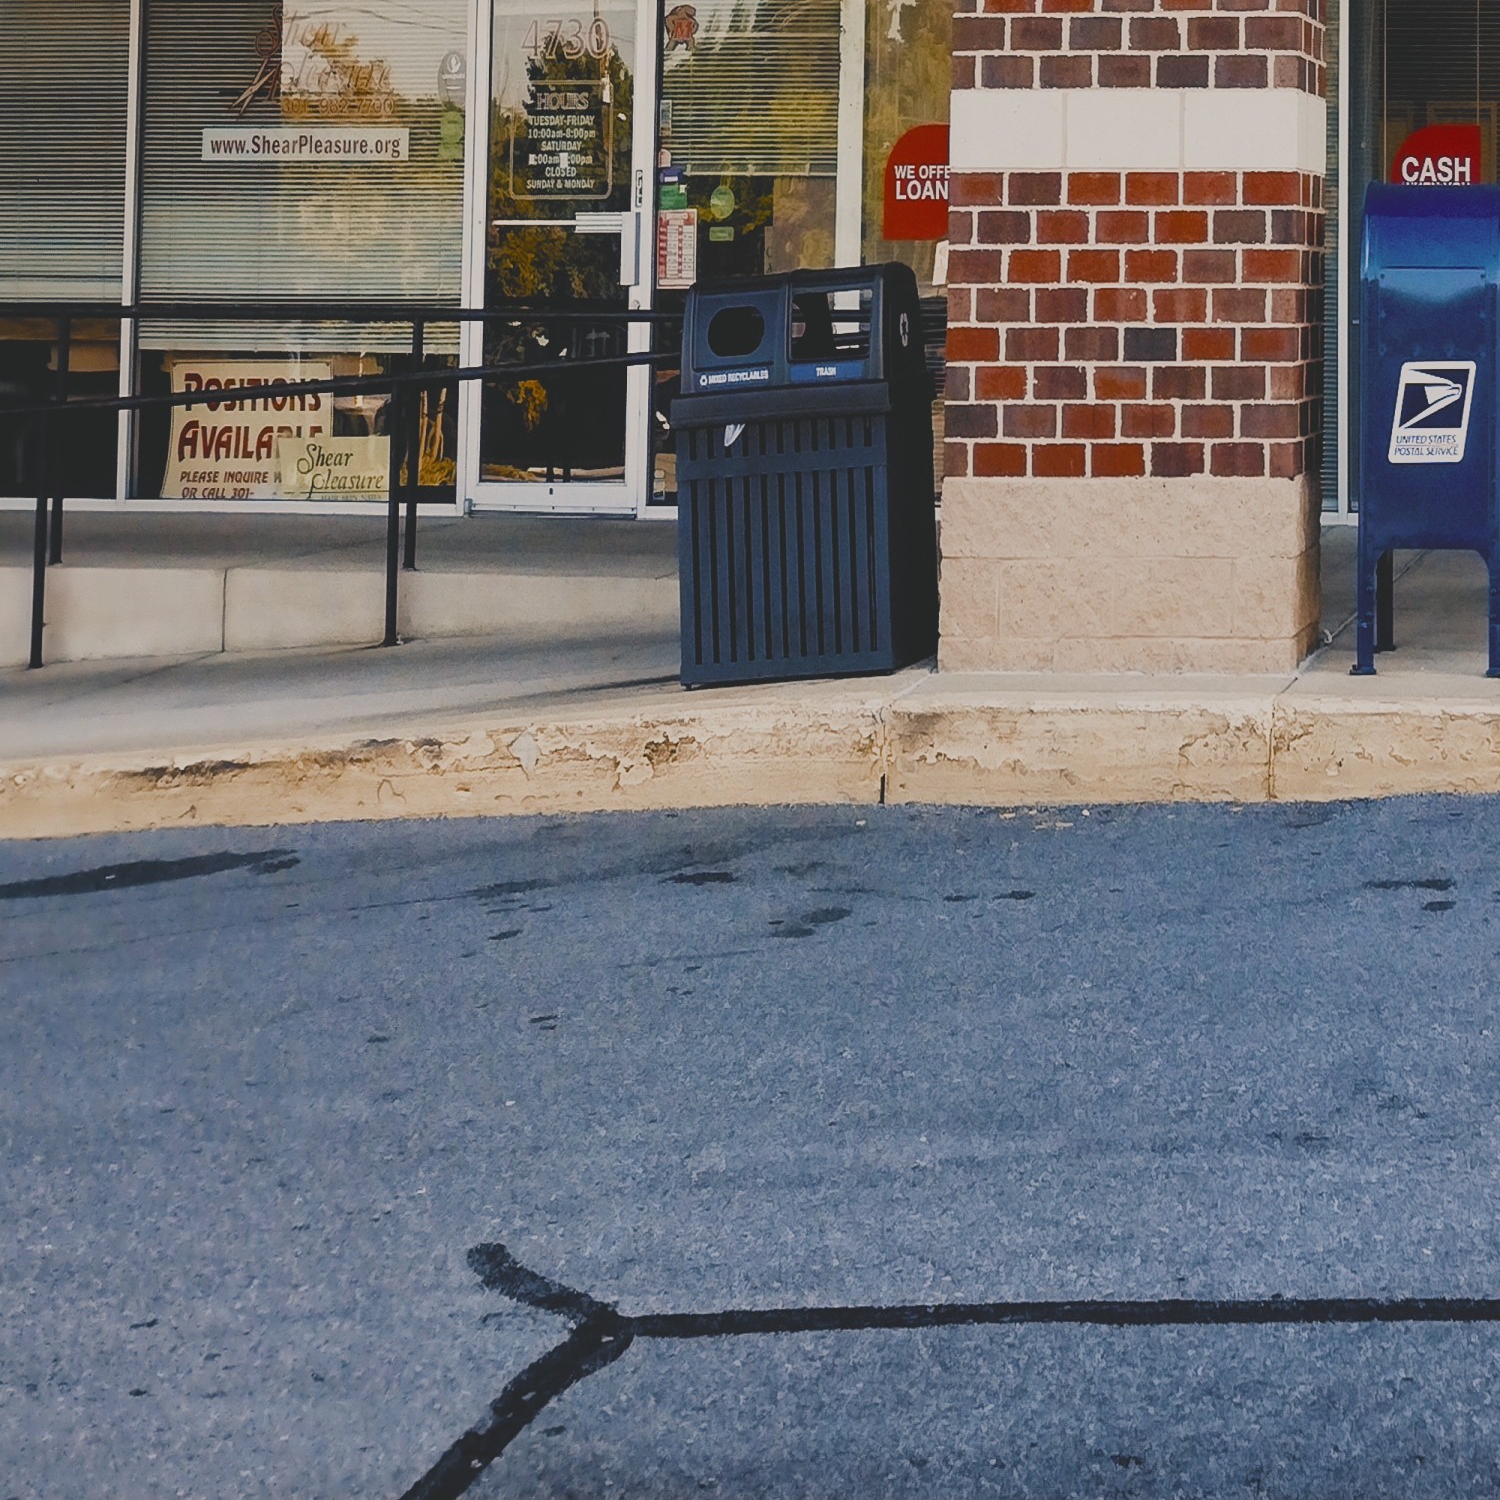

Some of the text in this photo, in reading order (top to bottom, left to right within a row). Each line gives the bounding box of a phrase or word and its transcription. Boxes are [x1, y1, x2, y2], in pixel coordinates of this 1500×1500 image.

[521, 16, 610, 60] 4730
[536, 92, 589, 110] HOURS
[529, 115, 595, 126] TUESDAY-FRIDAY
[528, 128, 596, 139] 10:00am-8:00pm
[211, 135, 400, 158] www.ShearPleasure.org
[541, 141, 582, 151] SATURDAY
[545, 167, 577, 177] CLOSED
[894, 165, 915, 179] WE
[1402, 157, 1471, 182] CASH
[527, 180, 555, 189] SUNDAY
[564, 180, 595, 189] MONDAY
[896, 180, 948, 200] LOAN
[184, 373, 322, 412] POSITIONS
[178, 420, 323, 463] AVAILA
[1397, 435, 1457, 445] UNITED STATES
[1395, 446, 1459, 456] POSTAL SERVICE
[297, 443, 354, 474] Shear
[180, 471, 219, 484] PLEASE
[224, 471, 269, 484] INQUIRE
[181, 487, 198, 500] OR
[201, 487, 226, 500] CALL
